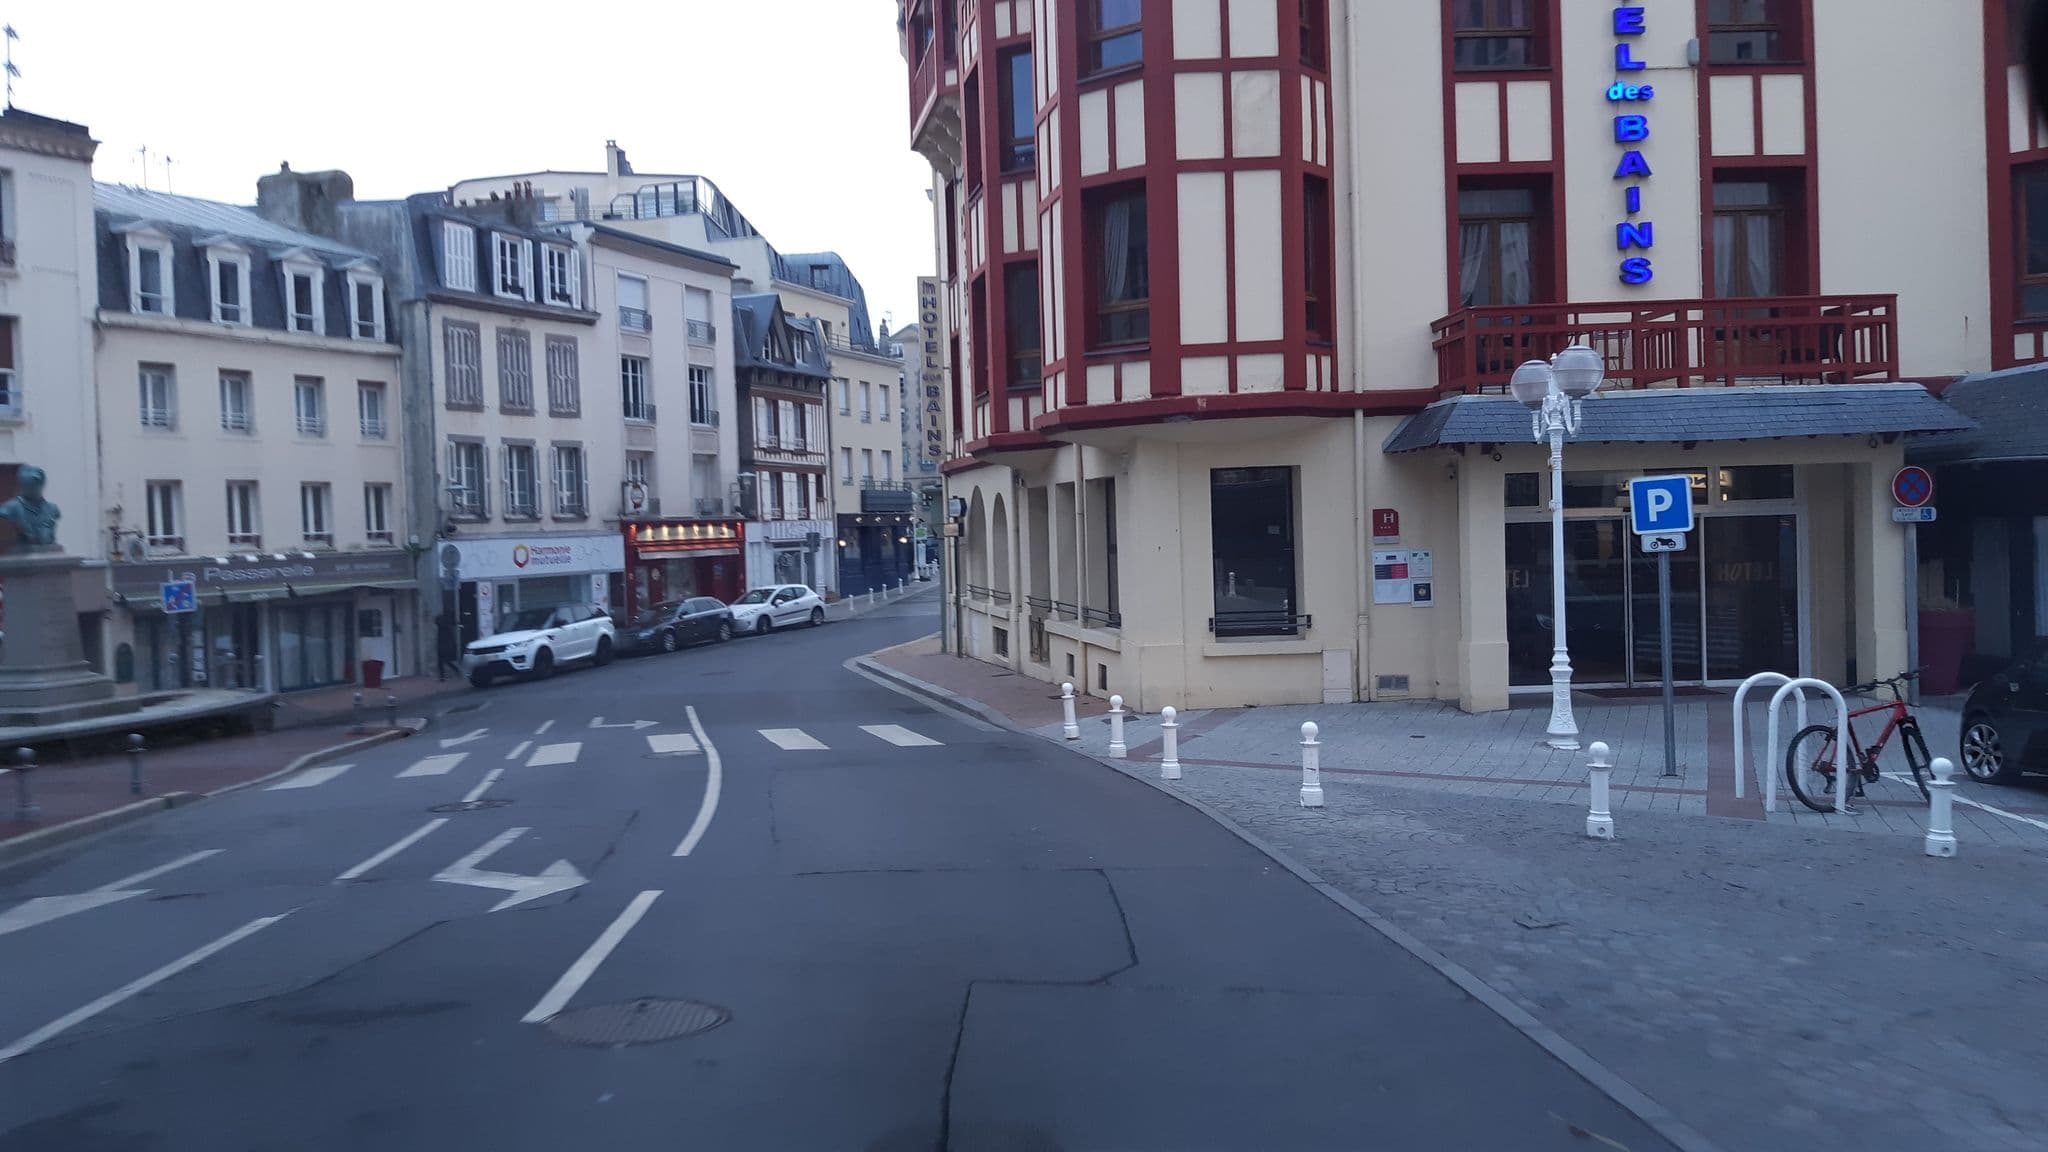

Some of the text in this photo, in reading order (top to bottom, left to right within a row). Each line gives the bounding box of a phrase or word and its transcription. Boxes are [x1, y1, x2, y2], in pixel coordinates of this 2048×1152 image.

[1606, 81, 1655, 102] des
[1613, 114, 1653, 285] BAINS
[922, 296, 938, 369] HOTEL
[926, 385, 942, 457] BAINS
[1383, 512, 1394, 523] H
[1646, 487, 1674, 522] P
[203, 563, 315, 582] Passerelle
